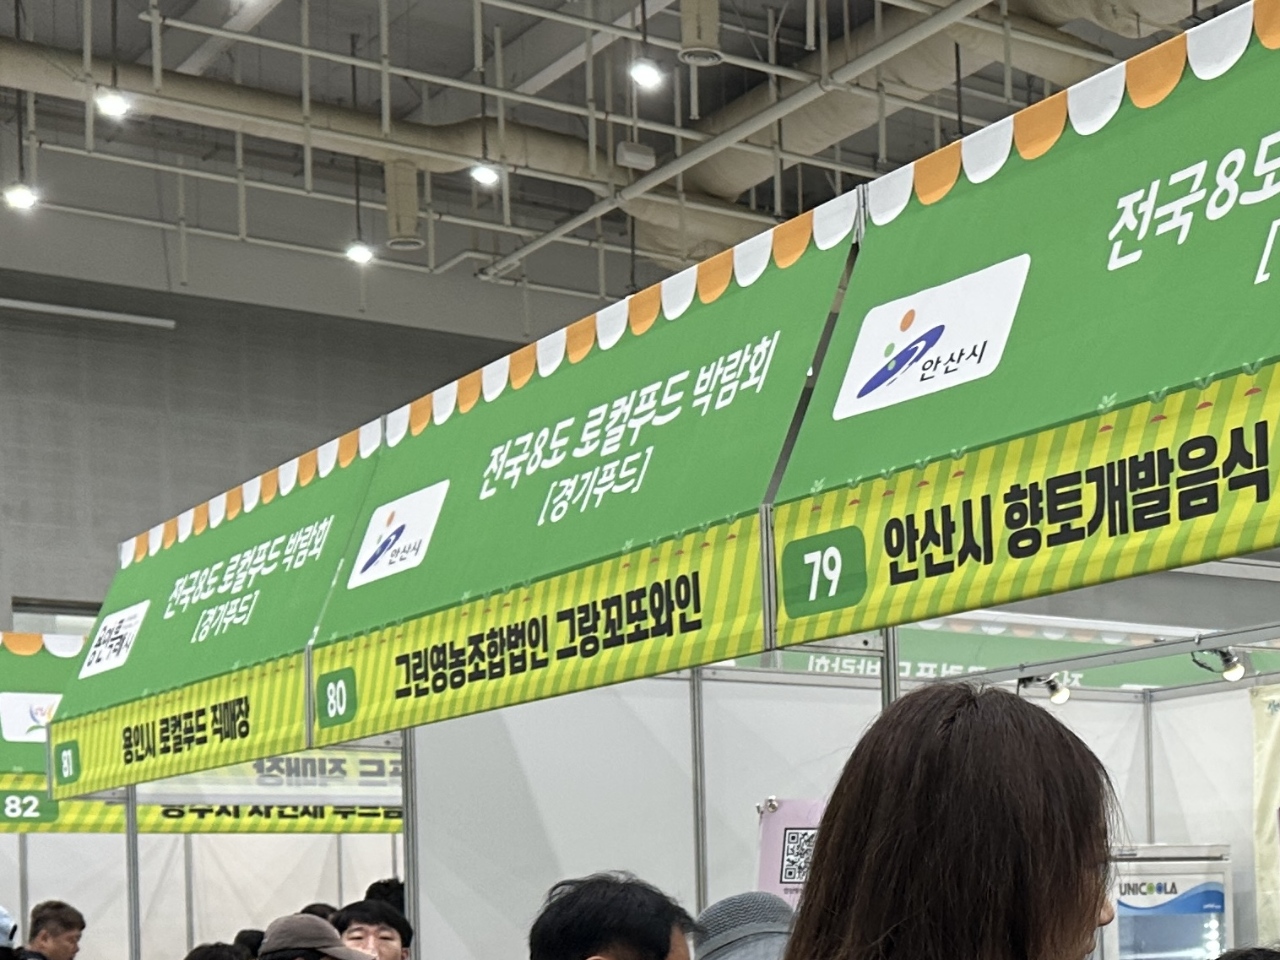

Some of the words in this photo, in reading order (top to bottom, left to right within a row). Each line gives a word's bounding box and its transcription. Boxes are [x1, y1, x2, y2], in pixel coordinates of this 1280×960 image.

[917, 339, 988, 383] 안산시
[480, 417, 574, 500] 전국8도
[572, 370, 689, 454] 로컬푸드
[693, 331, 780, 416] 박람회
[537, 447, 654, 526] [경기푸드]
[883, 495, 993, 589] 안산시
[1003, 422, 1270, 561] 향토개발음식
[164, 562, 225, 619] 전국8도
[218, 545, 283, 600] 로컬푸드
[284, 515, 334, 571] 박람회
[803, 546, 842, 602] 79
[191, 591, 260, 643] [경기푸드]
[394, 615, 548, 700] 그린영농조합법인
[556, 572, 702, 660] 그랑꼬또와인
[327, 679, 347, 719] 80
[122, 723, 156, 765] 용인시
[160, 709, 208, 755] 로컬푸드
[211, 696, 250, 740] 직매장
[61, 749, 73, 777] 81
[4, 795, 40, 818] 82
